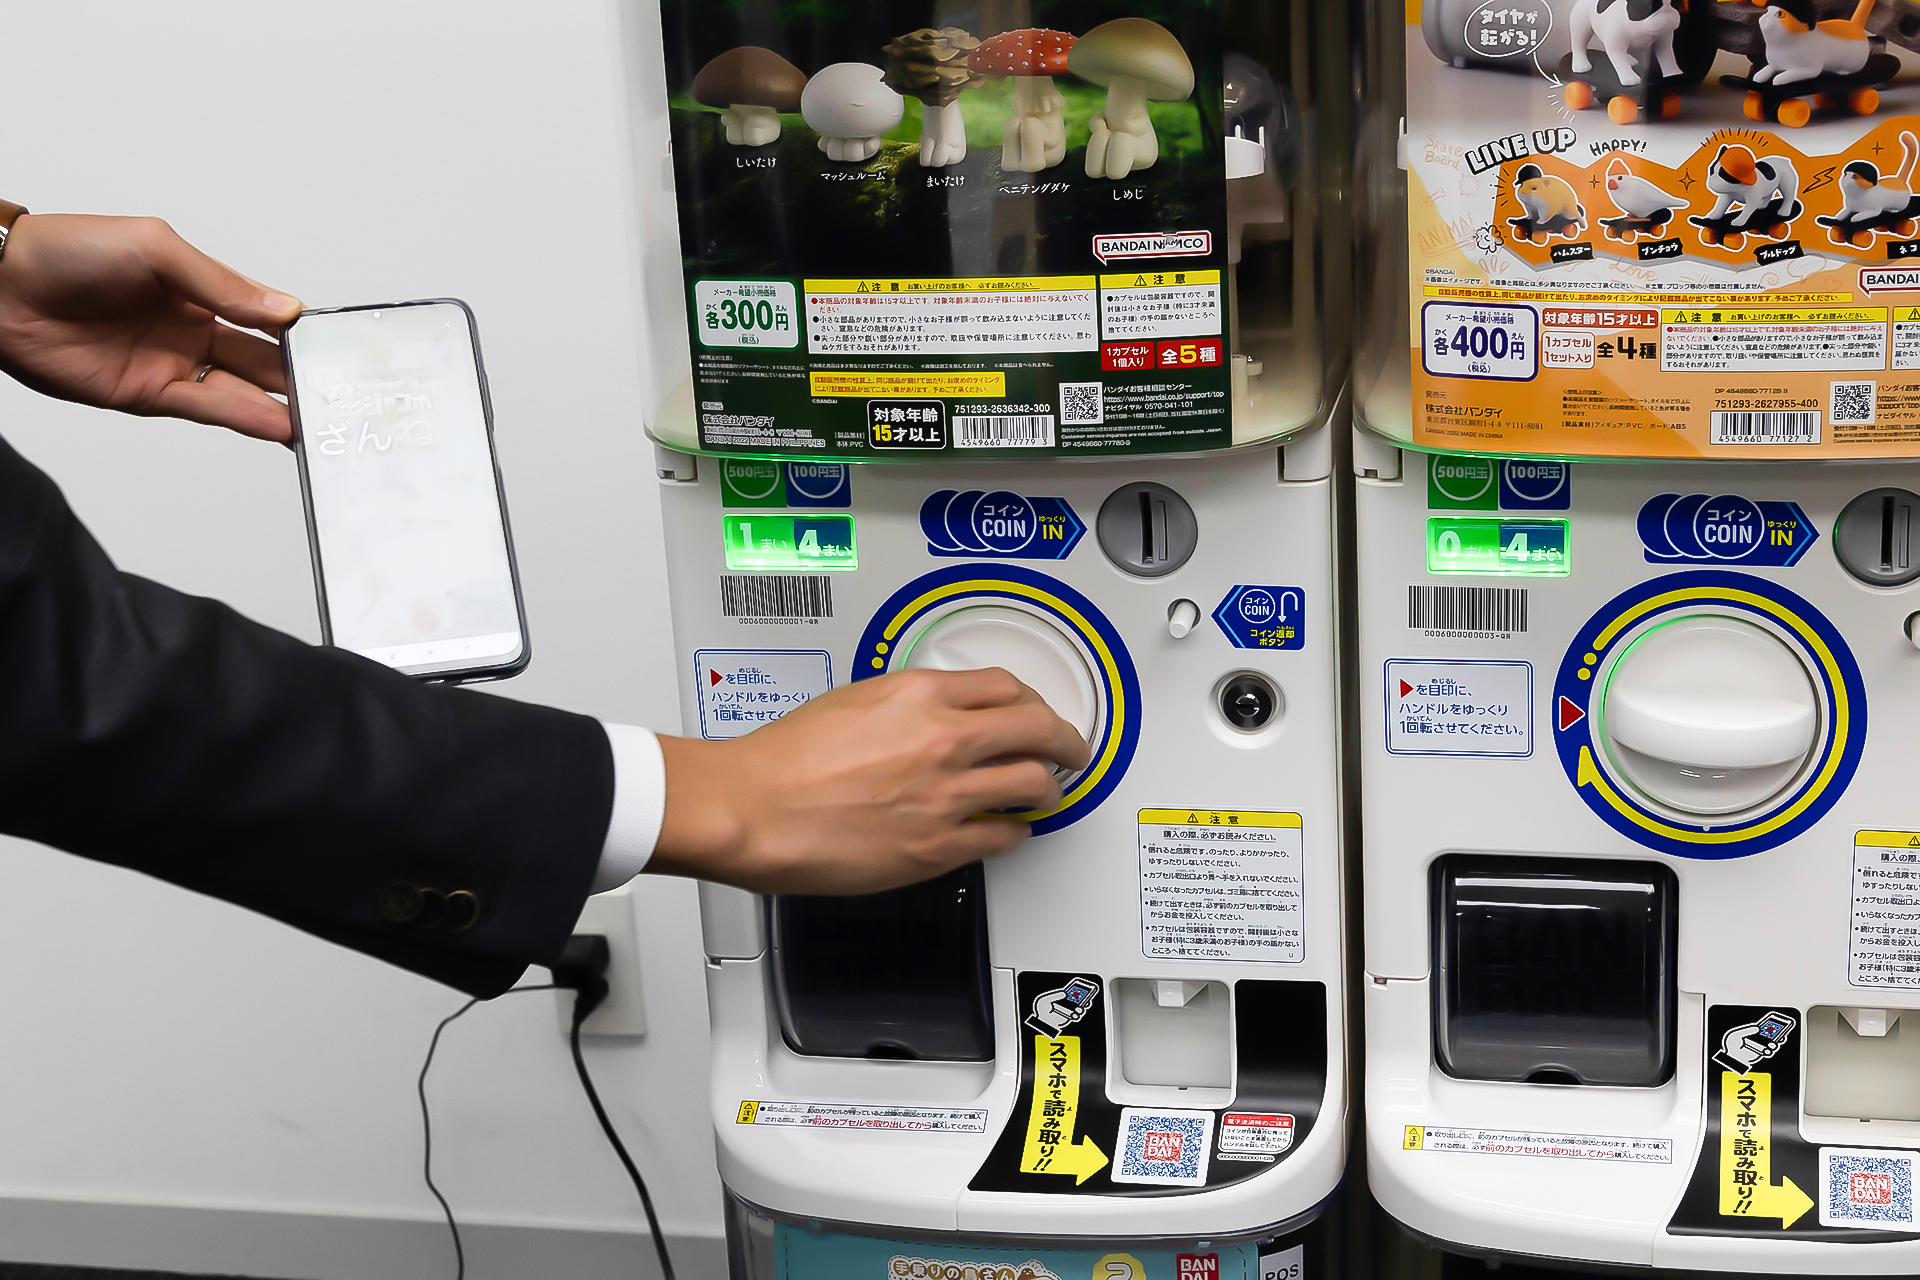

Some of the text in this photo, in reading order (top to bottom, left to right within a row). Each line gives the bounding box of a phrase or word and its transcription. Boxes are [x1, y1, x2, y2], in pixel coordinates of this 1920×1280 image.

[1480, 8, 1539, 25] タイヤが
[1423, 134, 1464, 156] Skate
[1465, 127, 1577, 175] LINE UP
[1589, 138, 1648, 156] HAPPY!
[736, 157, 777, 168] しいたけ
[1424, 150, 1460, 170] Board
[820, 171, 886, 182] マッシュルーム
[926, 175, 965, 188] まいたけ
[998, 182, 1071, 195] ベニテングダケ
[1113, 188, 1144, 200] しめじ
[1101, 240, 1150, 252] BANDAI
[1553, 246, 1591, 258] ハムスター
[1641, 243, 1680, 255] ブンチョウ
[1899, 244, 1919, 255] ネコ
[1759, 245, 1797, 261] ブルドッグ
[1866, 273, 1919, 285] BANDAI
[705, 303, 718, 311] かく
[705, 299, 789, 331] 各300円
[1445, 313, 1514, 325] メーカー希望小売価格
[1544, 310, 1656, 327] 対象年齢15才以上
[1433, 328, 1447, 337] かく
[1510, 332, 1525, 341] えん
[1433, 325, 1526, 361] 各400円
[1545, 335, 1592, 348] 1カプセル
[1596, 335, 1657, 360] 全4種
[1106, 346, 1149, 357] 1カプセル
[1161, 344, 1217, 365] 全5種
[1545, 351, 1592, 363] 1セット入り
[1112, 357, 1145, 368] 1個入り
[1425, 390, 1447, 399] 発売元
[954, 404, 1051, 414] 751293-2636342-300
[1104, 401, 1193, 412] ナビダイヤル 0570-041-101
[1714, 398, 1819, 408] 751293-2627955-400
[873, 407, 939, 423] 対象年齢
[1425, 403, 1503, 418] 株式会社バンダイ
[872, 424, 941, 442] 15才以上
[1718, 435, 1762, 443] 4549660
[1769, 435, 1800, 443] 77127
[960, 438, 1001, 447] 4549660
[1007, 438, 1036, 446] 77779
[728, 465, 775, 478] 500円玉
[793, 465, 840, 478] 100円玉
[1437, 465, 1488, 479] 500円玉
[1510, 465, 1561, 479] 100円玉
[983, 505, 1024, 517] コイン
[1707, 509, 1752, 522] コイン
[1038, 515, 1066, 523] ゆっくり
[1767, 520, 1797, 529] ゆっくり
[982, 518, 1026, 538] COIN
[1042, 524, 1063, 540] IN
[1704, 524, 1753, 544] COIN
[1770, 529, 1794, 546] IN
[1244, 605, 1270, 616] COIN
[1250, 629, 1295, 638] コイン返却
[1259, 638, 1285, 646] ボタン
[725, 673, 777, 685] を目印に、
[1416, 684, 1473, 696] を目印に、
[711, 691, 811, 703] ハンドルをゆっくり
[712, 708, 792, 721] 1回転させてく
[1399, 702, 1509, 716] ハンドルをゆっくり
[1399, 720, 1524, 736] 1回転させてください。
[1150, 1134, 1181, 1147] BAN
[1148, 1145, 1174, 1158] DAI
[1854, 1177, 1889, 1189] BAN
[1853, 1187, 1882, 1200] DAI
[1180, 1258, 1215, 1271] BAN
